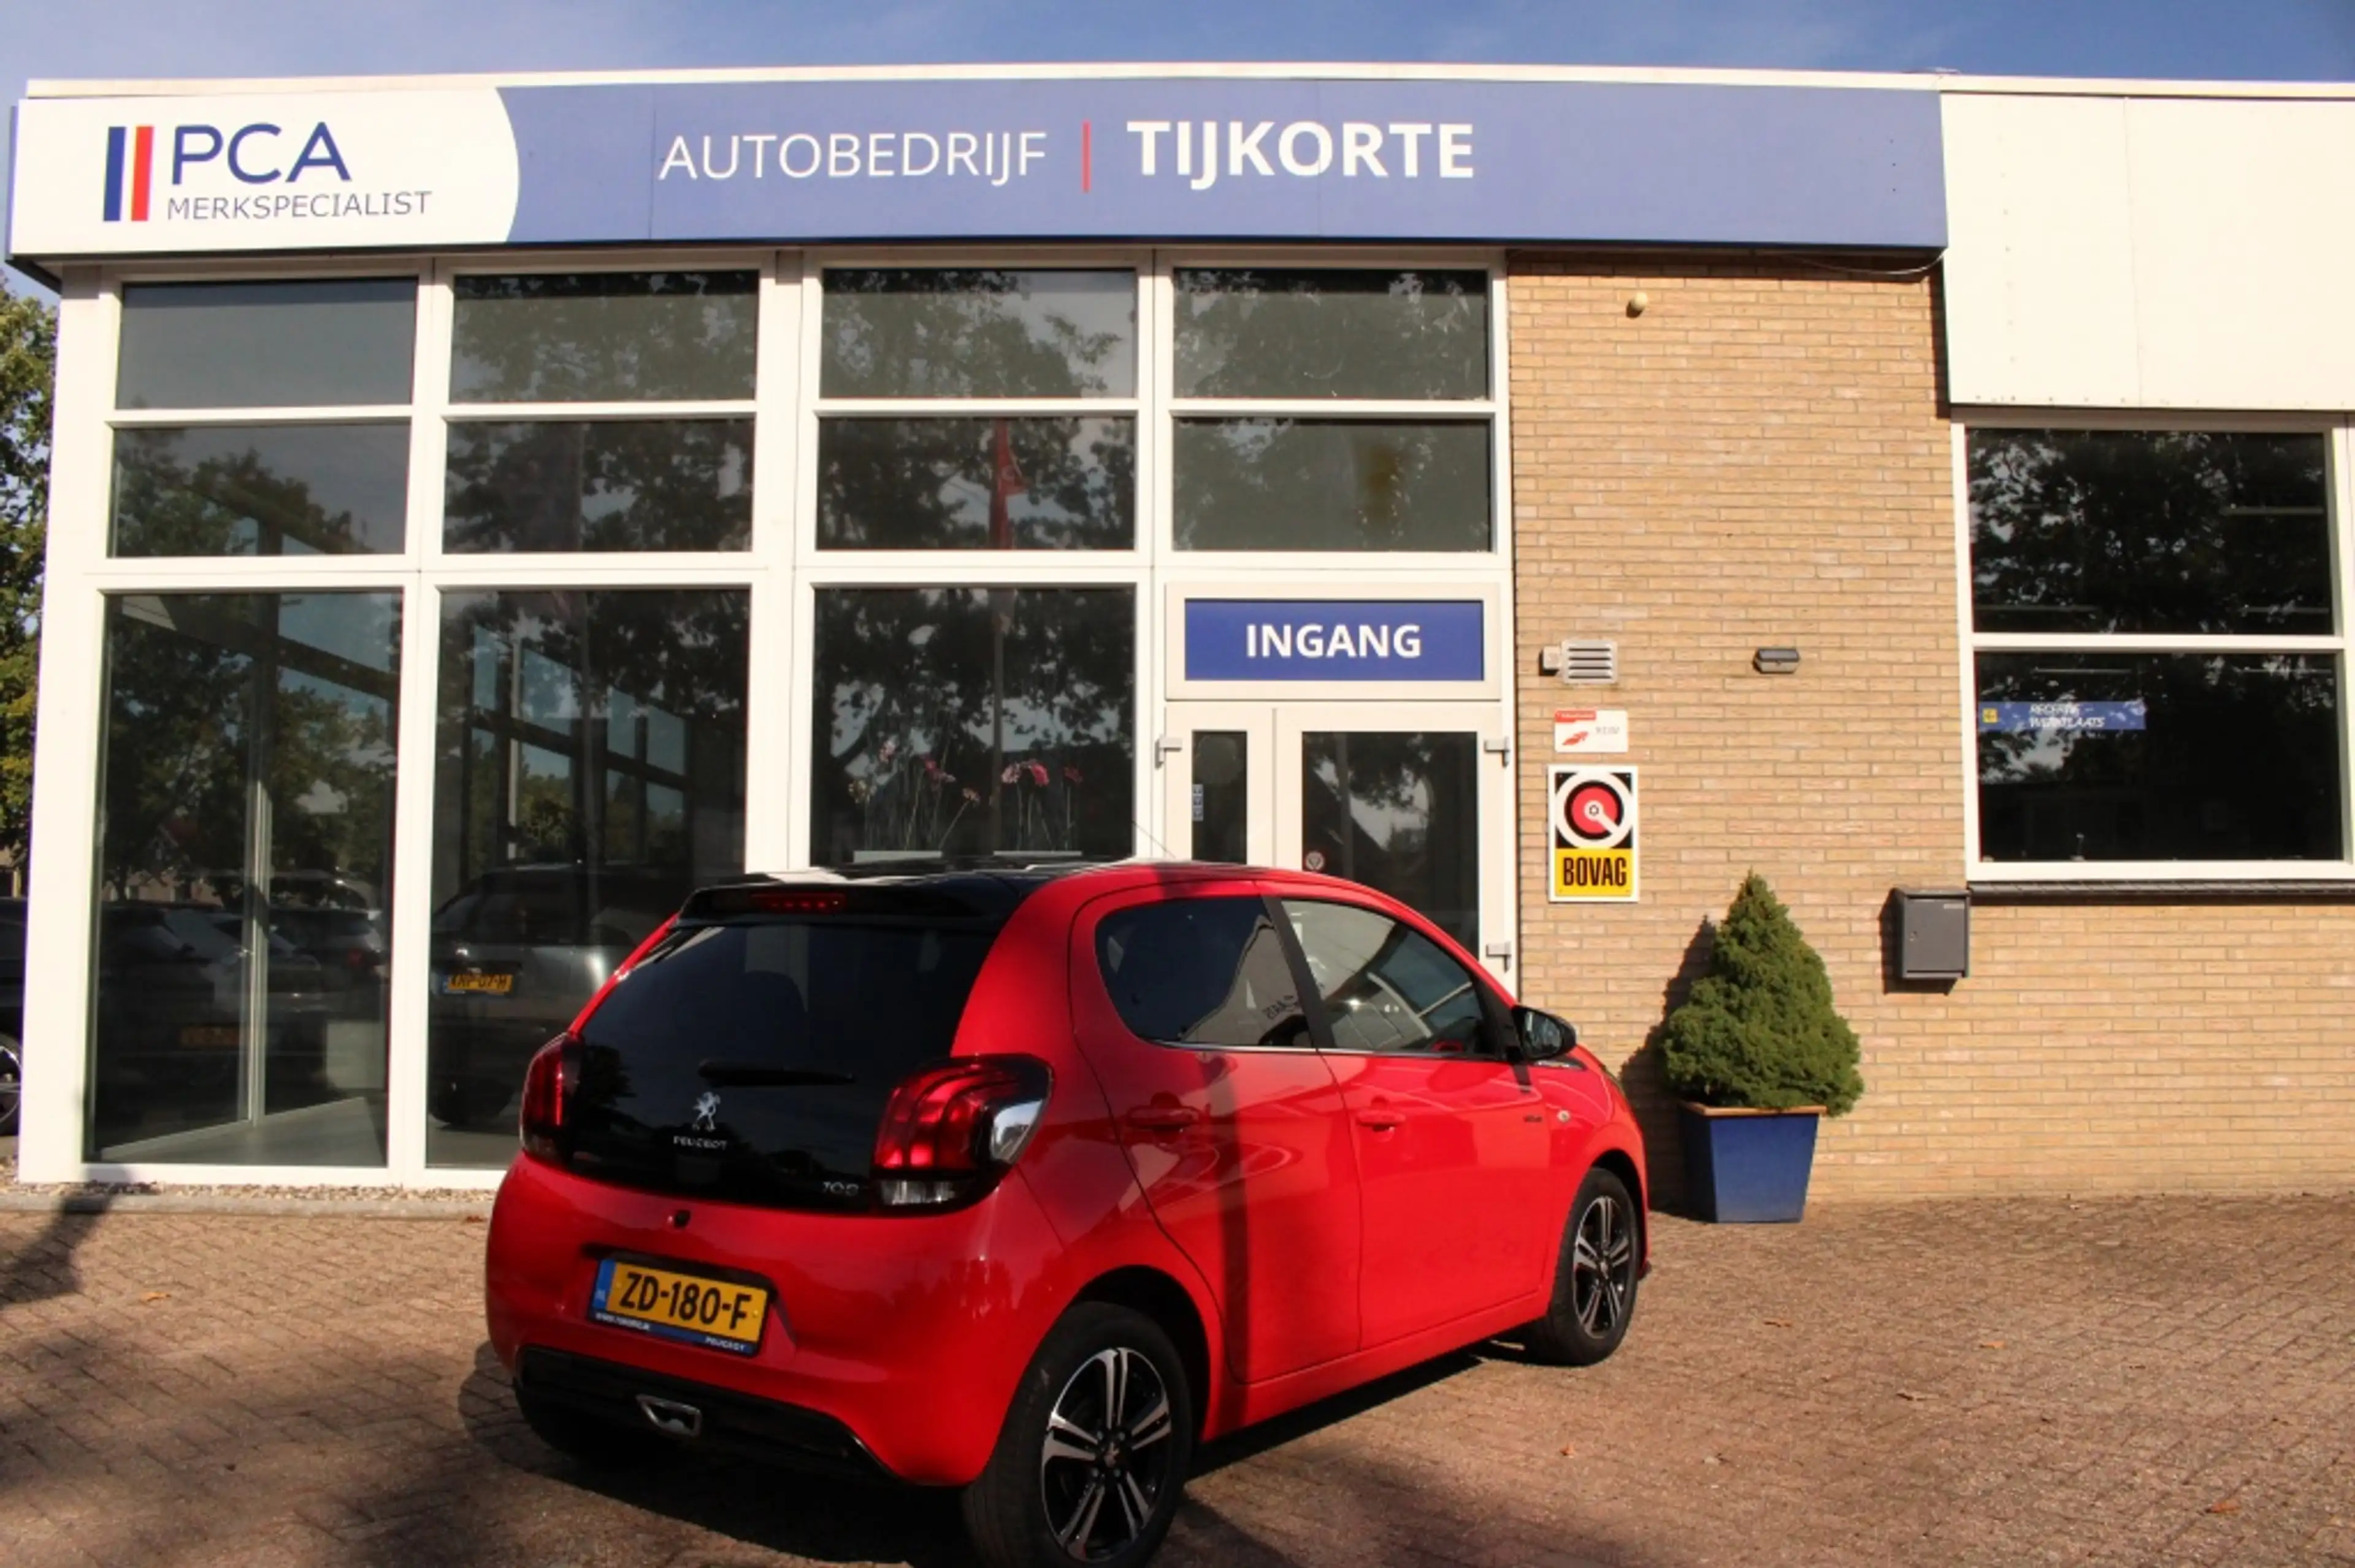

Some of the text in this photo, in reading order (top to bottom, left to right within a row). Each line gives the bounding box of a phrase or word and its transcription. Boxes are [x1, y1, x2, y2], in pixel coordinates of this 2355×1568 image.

[172, 121, 351, 185] PCA
[659, 120, 1474, 190] AUTOBEDRIJF TIJKORTE
[167, 191, 431, 220] MERKSPECIALIST
[1246, 624, 1421, 658] INGANG
[1563, 857, 1626, 887] BOVAG
[673, 1136, 727, 1150] PEUGEOT
[619, 1272, 752, 1329] ZD-180-F
